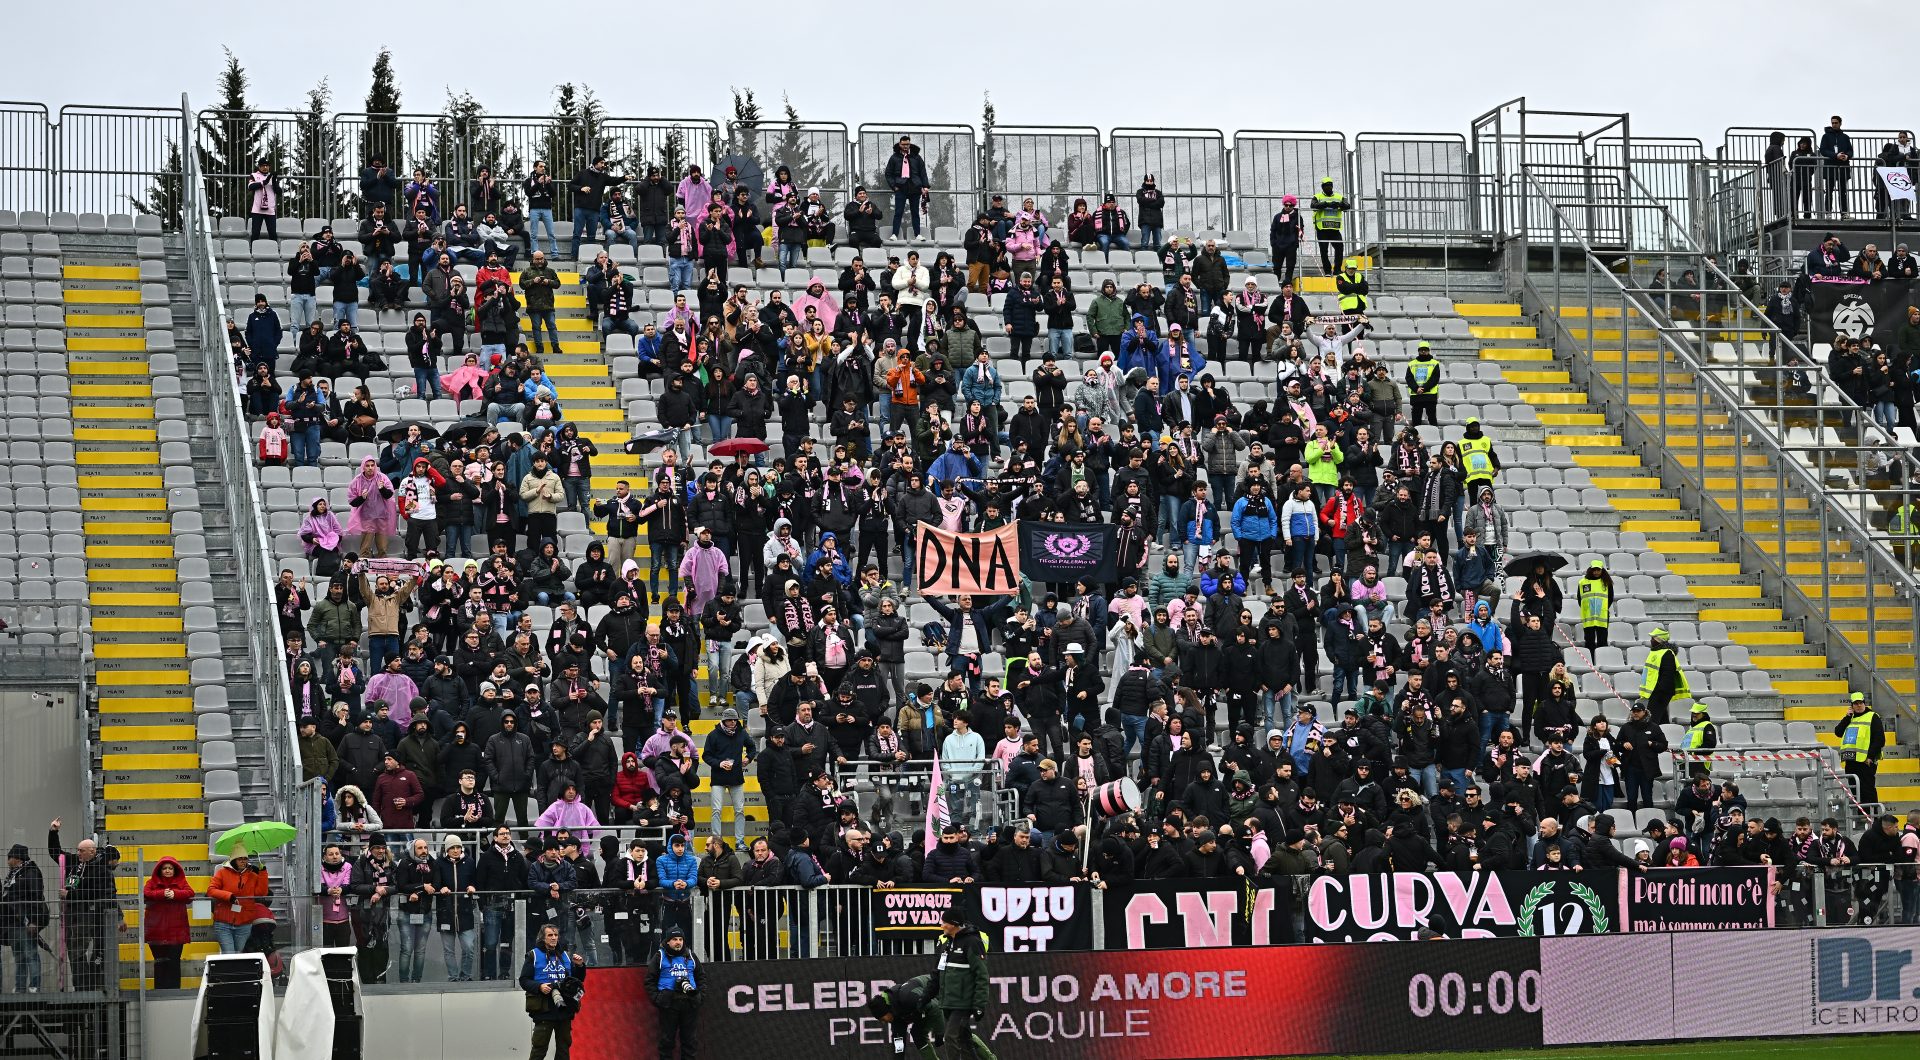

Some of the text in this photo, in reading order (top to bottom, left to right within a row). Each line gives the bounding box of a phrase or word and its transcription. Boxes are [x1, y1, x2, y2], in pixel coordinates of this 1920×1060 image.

[919, 527, 1018, 591] DNA
[885, 894, 952, 908] OVUNQUE
[980, 886, 1075, 923] ODIO
[1308, 871, 1517, 931] CURVA
[1634, 877, 1763, 906] Per chi non c'è
[888, 911, 908, 925] TU
[1537, 902, 1584, 935] 12
[990, 974, 1079, 1004] TUO
[1090, 970, 1247, 1001] AMORE
[1408, 969, 1542, 1018] 00:00
[990, 1009, 1150, 1043] AQUILE
[1818, 1006, 1918, 1025] CENTRO
